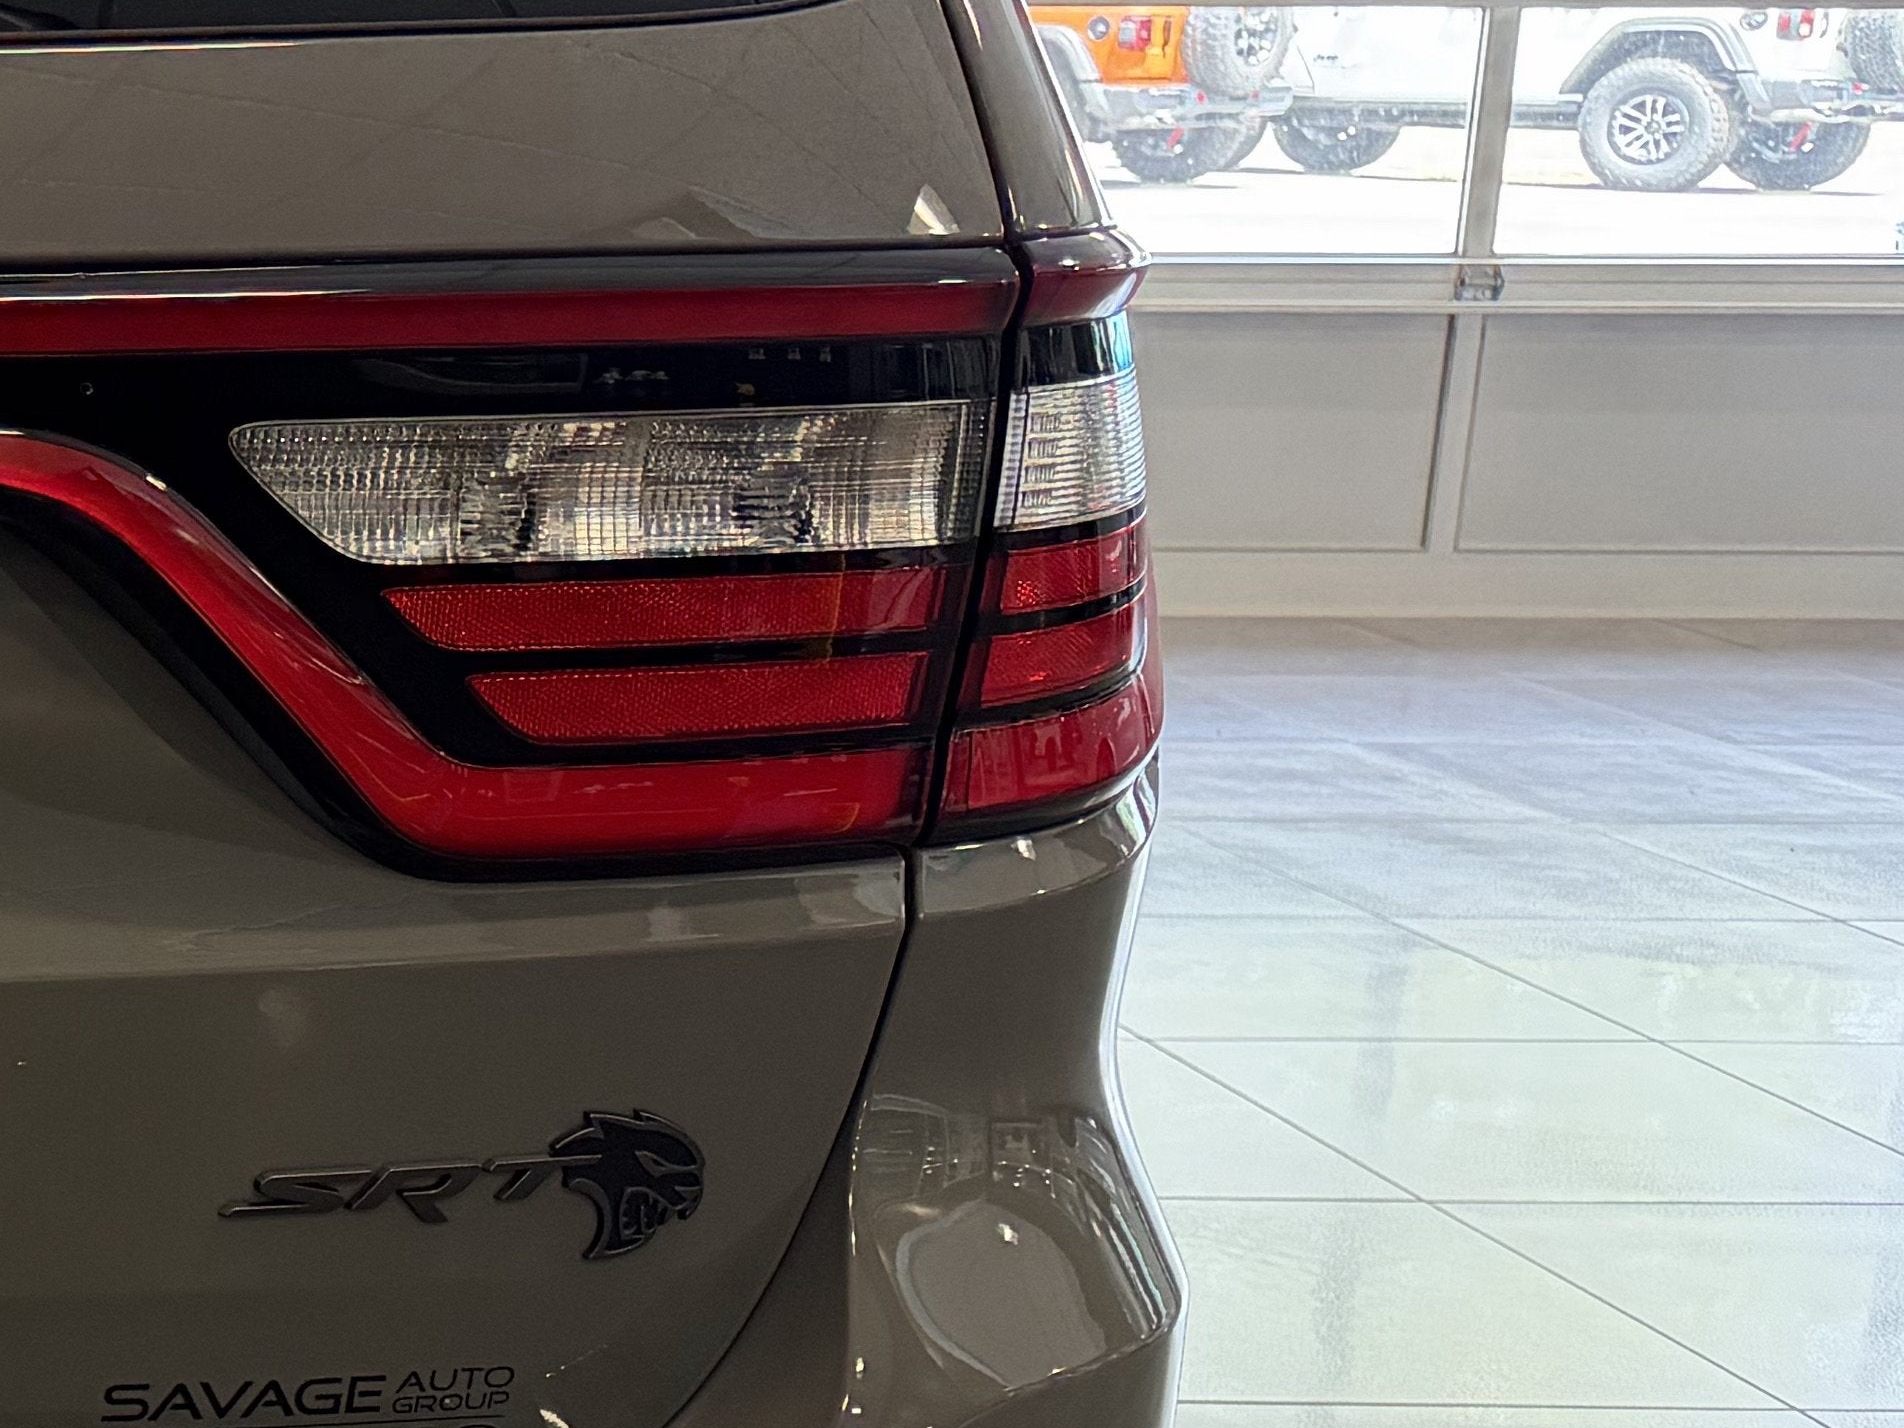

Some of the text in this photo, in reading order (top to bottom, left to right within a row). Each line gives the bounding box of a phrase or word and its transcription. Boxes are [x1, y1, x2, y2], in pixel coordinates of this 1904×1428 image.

[218, 1154, 602, 1224] SRT
[100, 1375, 388, 1423] SAVAGE
[394, 1366, 515, 1394] AUTO
[392, 1391, 510, 1414] GROUP
